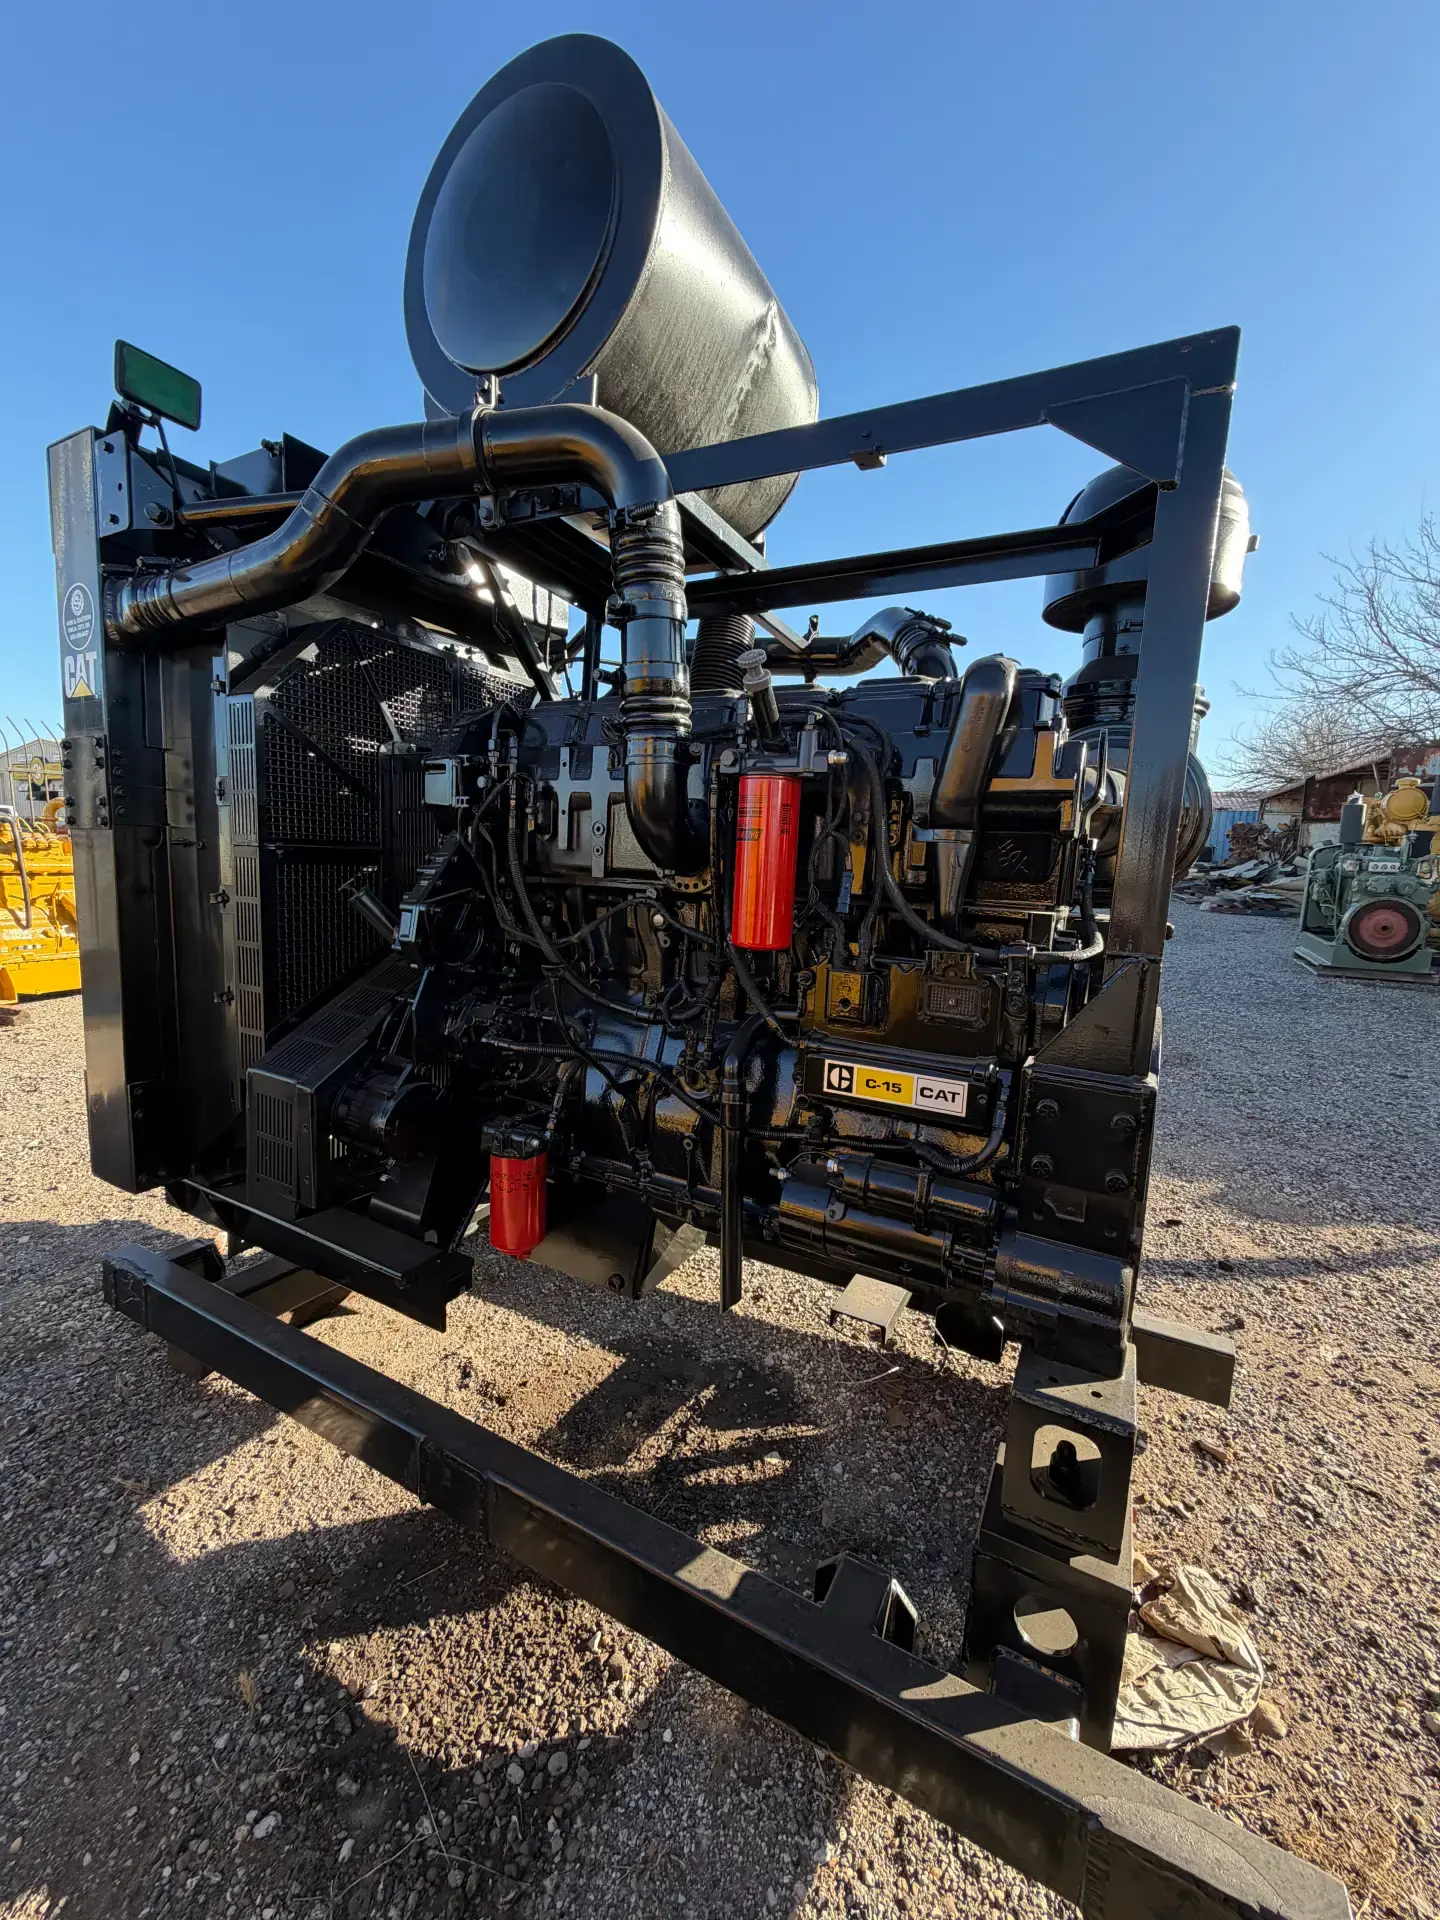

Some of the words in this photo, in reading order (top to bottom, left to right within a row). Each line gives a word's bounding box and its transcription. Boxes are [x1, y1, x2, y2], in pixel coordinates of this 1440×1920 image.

[65, 651, 97, 699] CAT
[865, 1078, 902, 1094] C-15
[919, 1086, 961, 1104] CAT
